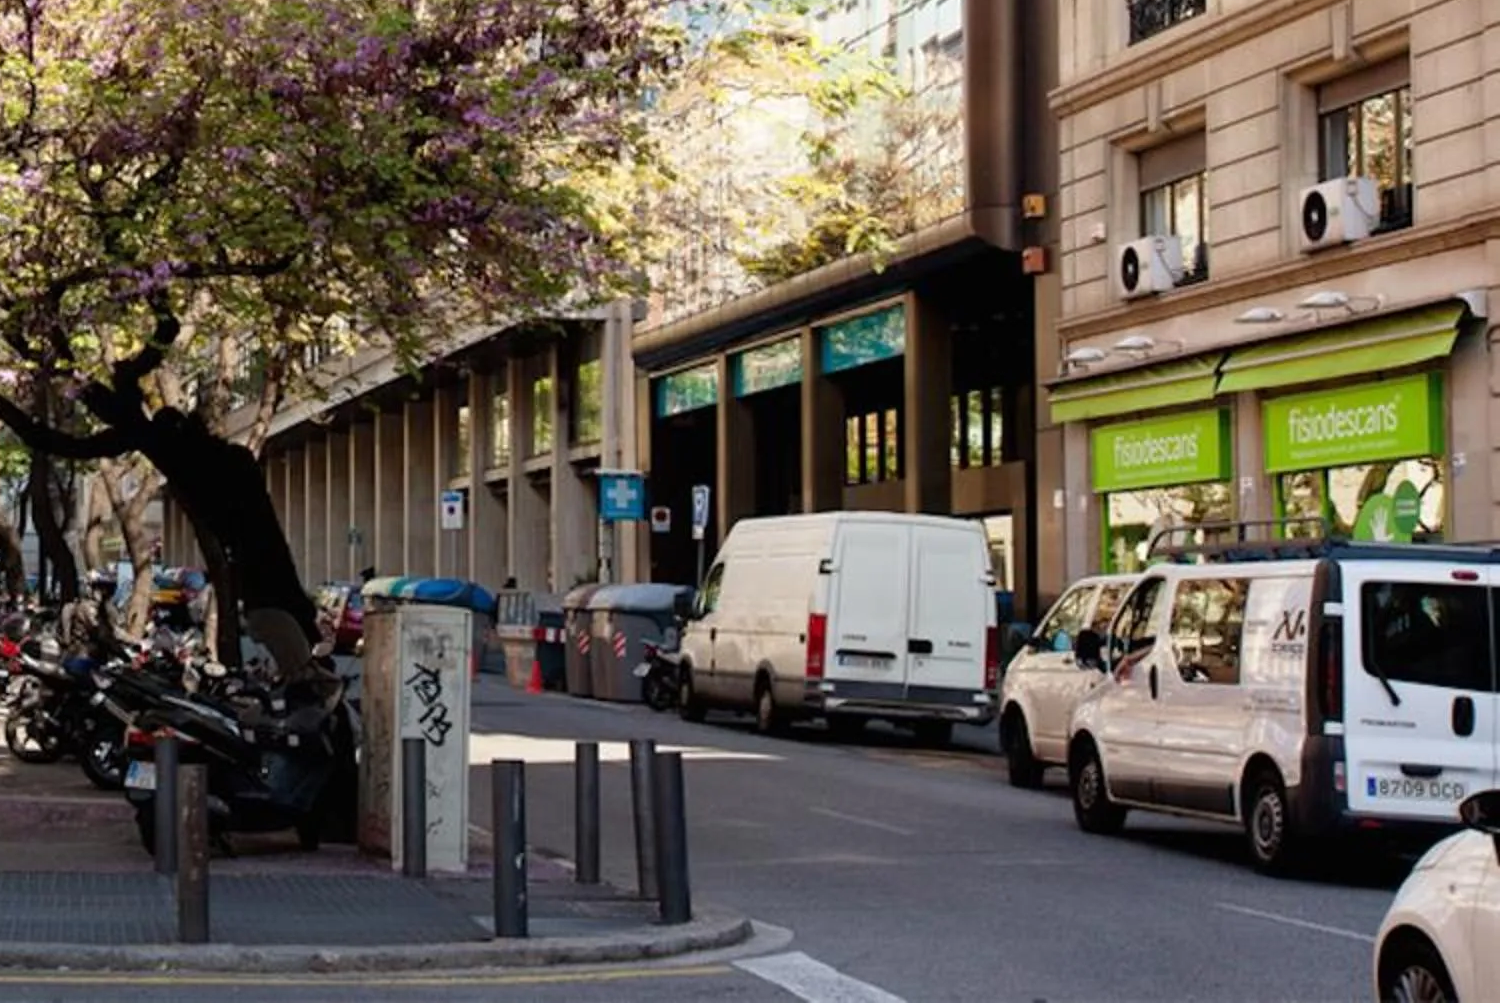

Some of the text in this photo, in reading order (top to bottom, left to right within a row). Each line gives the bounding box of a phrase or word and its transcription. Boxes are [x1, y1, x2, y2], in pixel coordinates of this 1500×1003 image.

[1288, 402, 1398, 445] fisiodescans
[1113, 431, 1199, 469] fisiodescans
[1379, 778, 1426, 797] 8709
